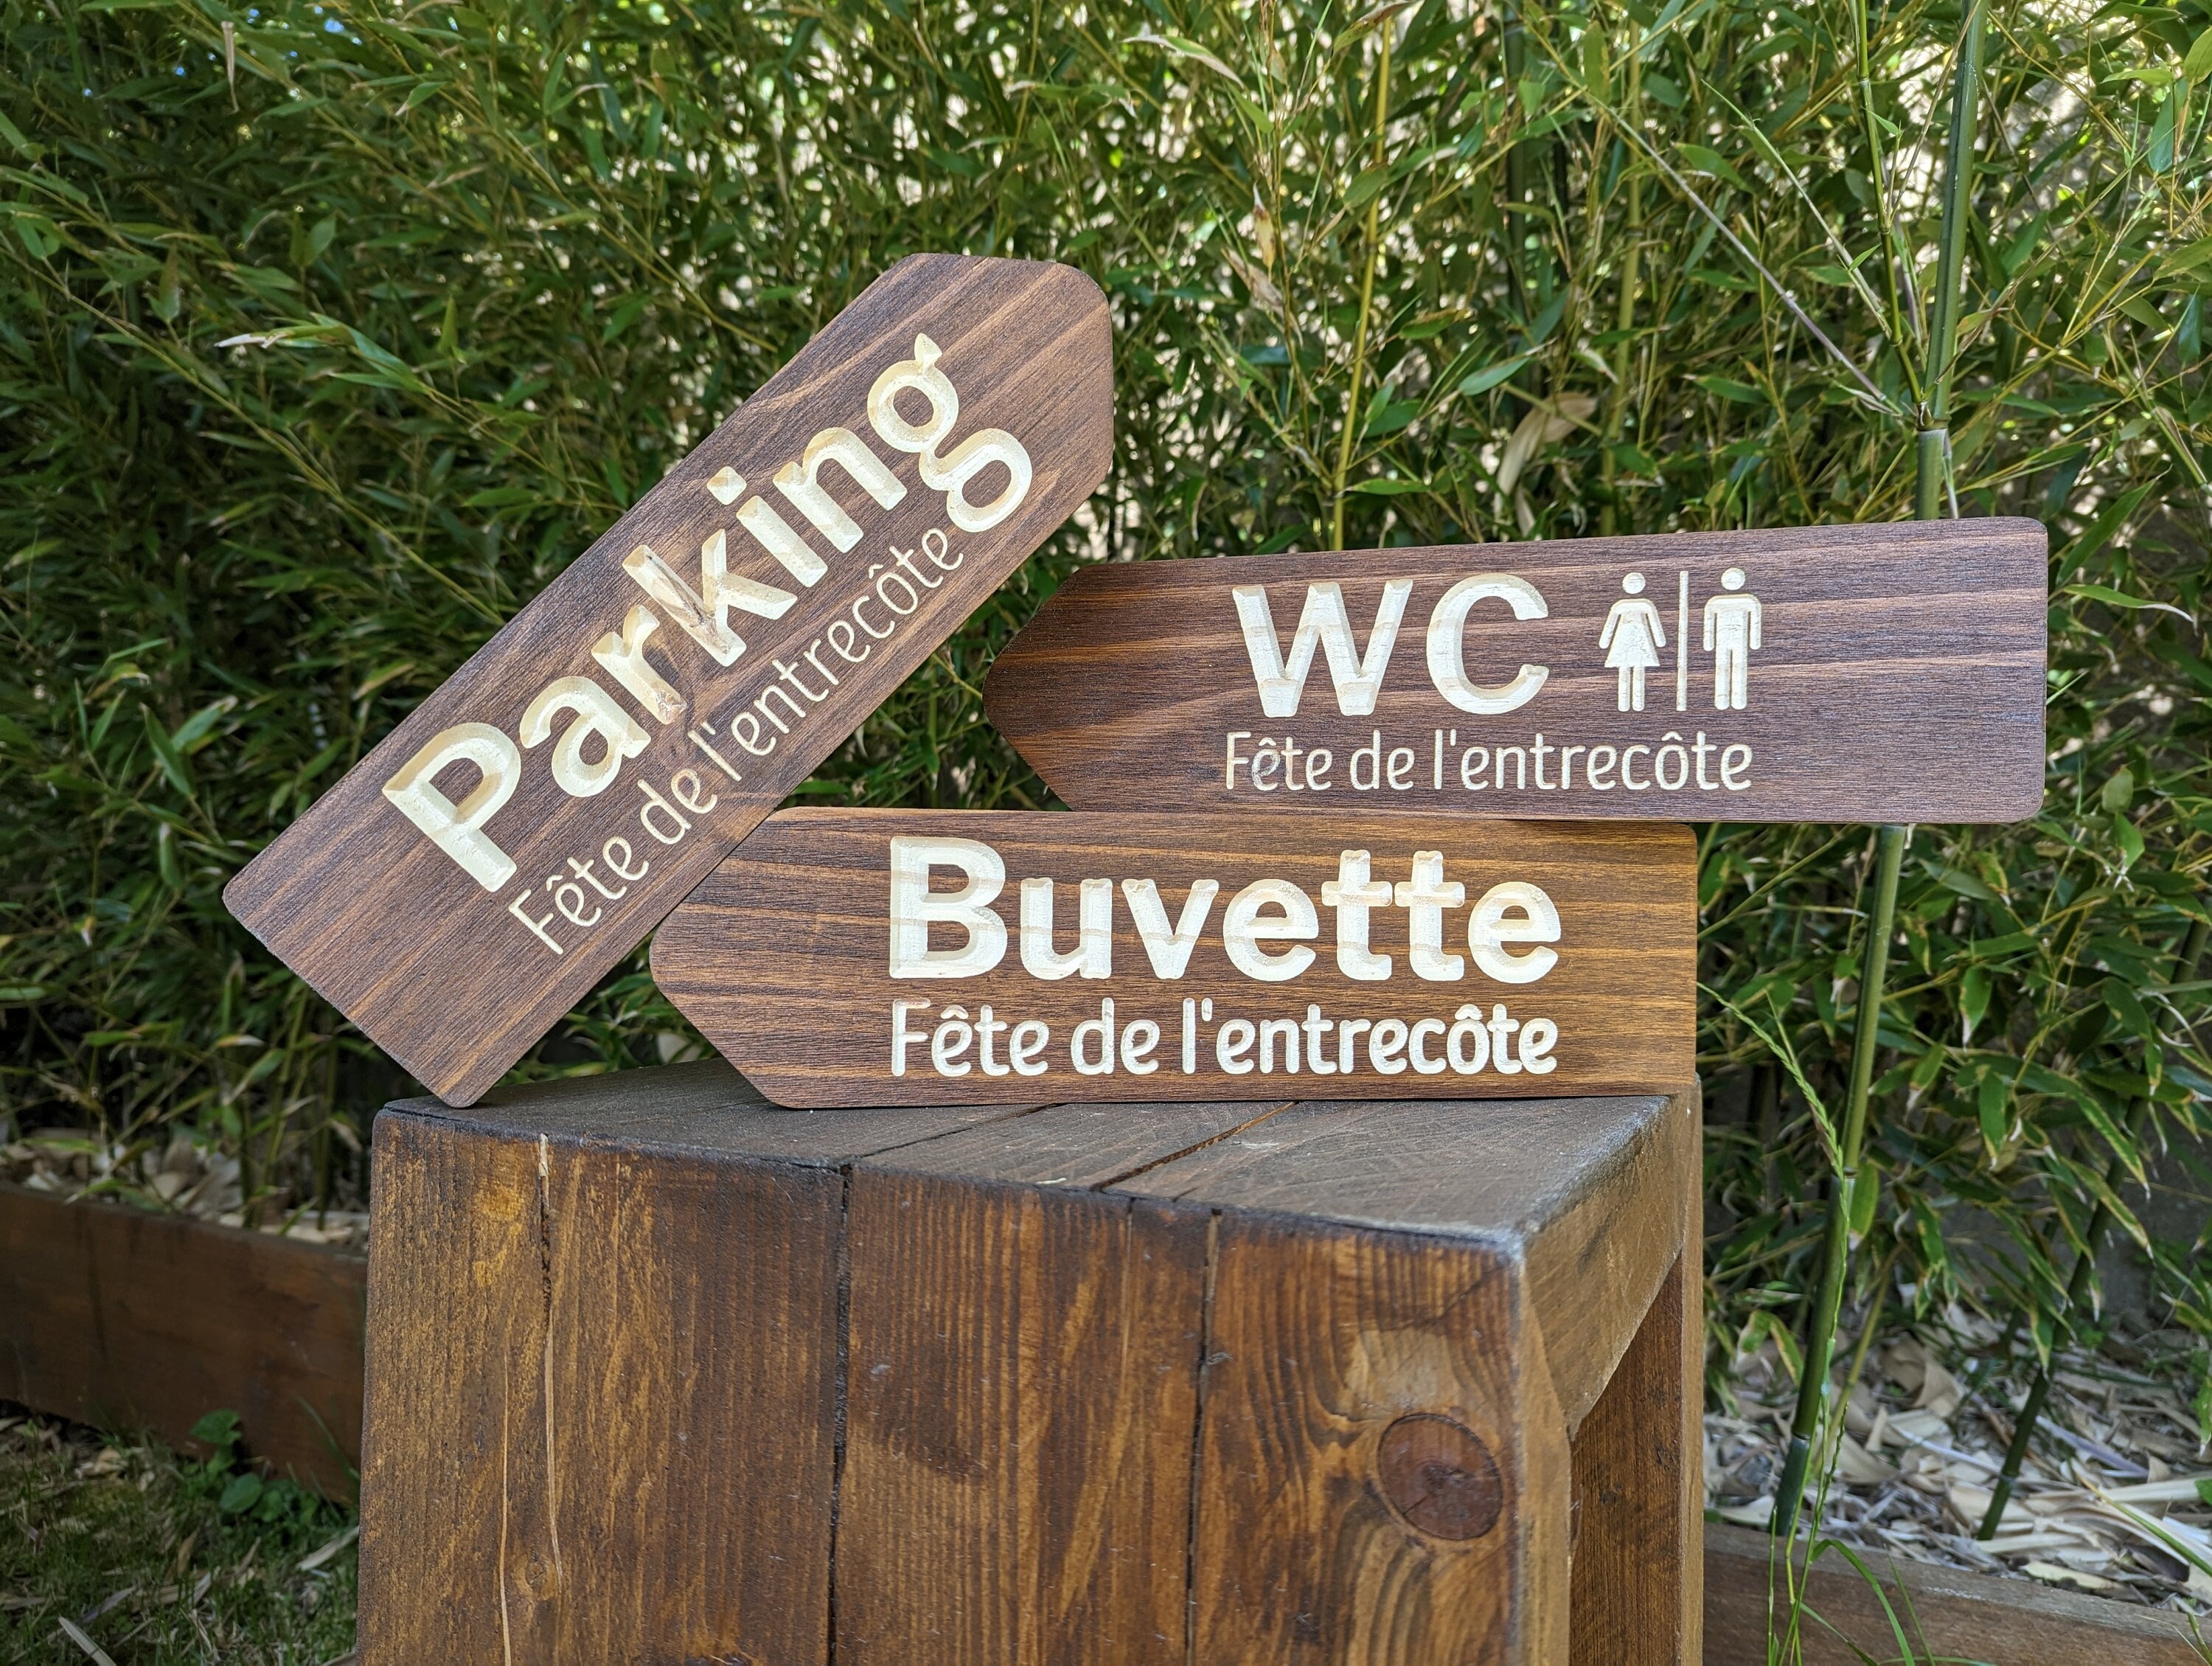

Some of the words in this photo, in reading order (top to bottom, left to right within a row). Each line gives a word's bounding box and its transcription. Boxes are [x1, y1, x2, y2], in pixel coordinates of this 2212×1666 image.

[381, 333, 1034, 892] Parking
[1232, 573, 1550, 718] WC
[508, 835, 650, 956] Fête
[637, 768, 717, 846] de
[687, 526, 964, 783] l'entrecôte
[1225, 731, 1333, 791] Fête
[1349, 728, 1416, 791] de
[1433, 728, 1753, 791] l'entrecôte
[888, 836, 1562, 984] Buvette
[891, 997, 1049, 1077] Fête
[1070, 996, 1160, 1076] de
[1181, 996, 1559, 1075] l'entrecôte
